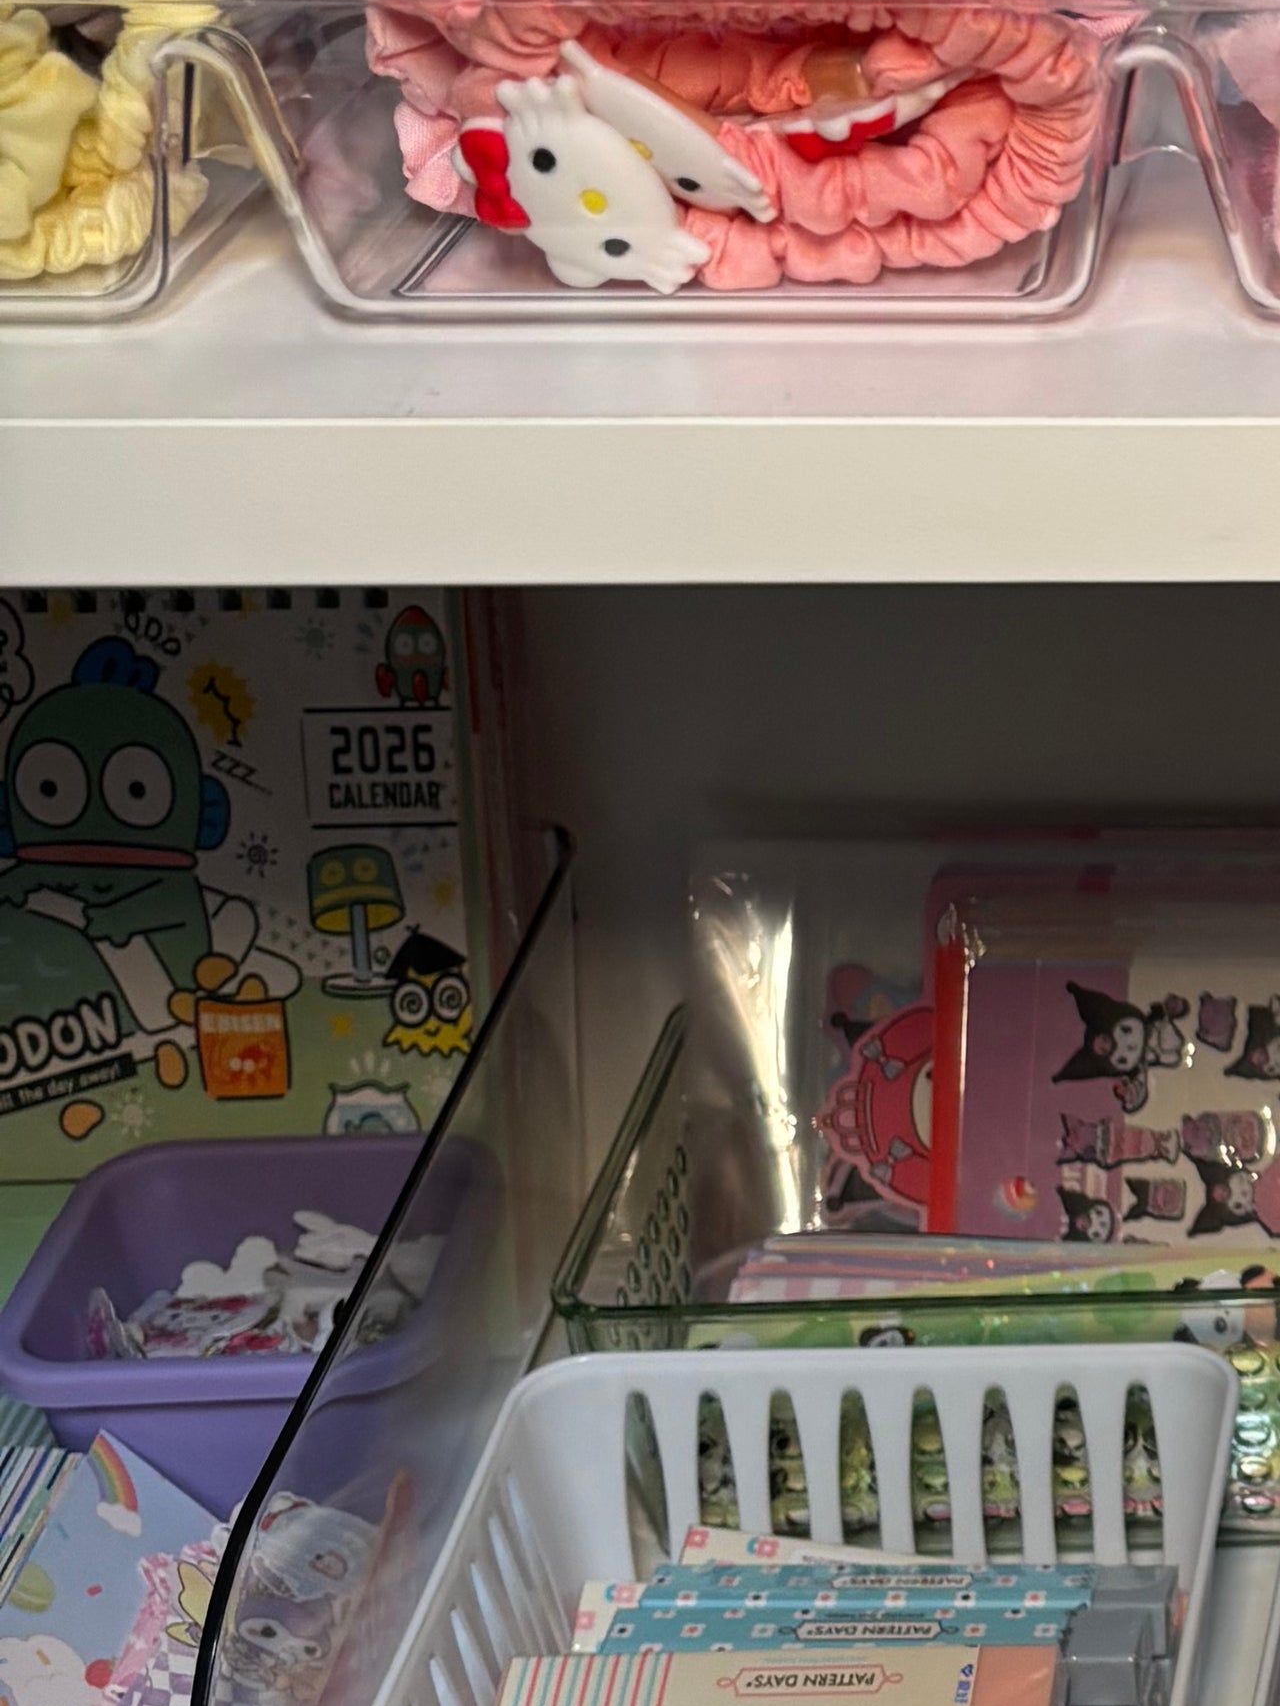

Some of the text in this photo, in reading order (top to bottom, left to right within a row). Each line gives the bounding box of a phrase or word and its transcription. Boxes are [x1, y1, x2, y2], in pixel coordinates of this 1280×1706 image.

[329, 724, 436, 775] 2026
[328, 780, 442, 811] CALENDAR
[863, 1625, 933, 1637] PATTERN
[803, 1672, 876, 1688] PATTERN
